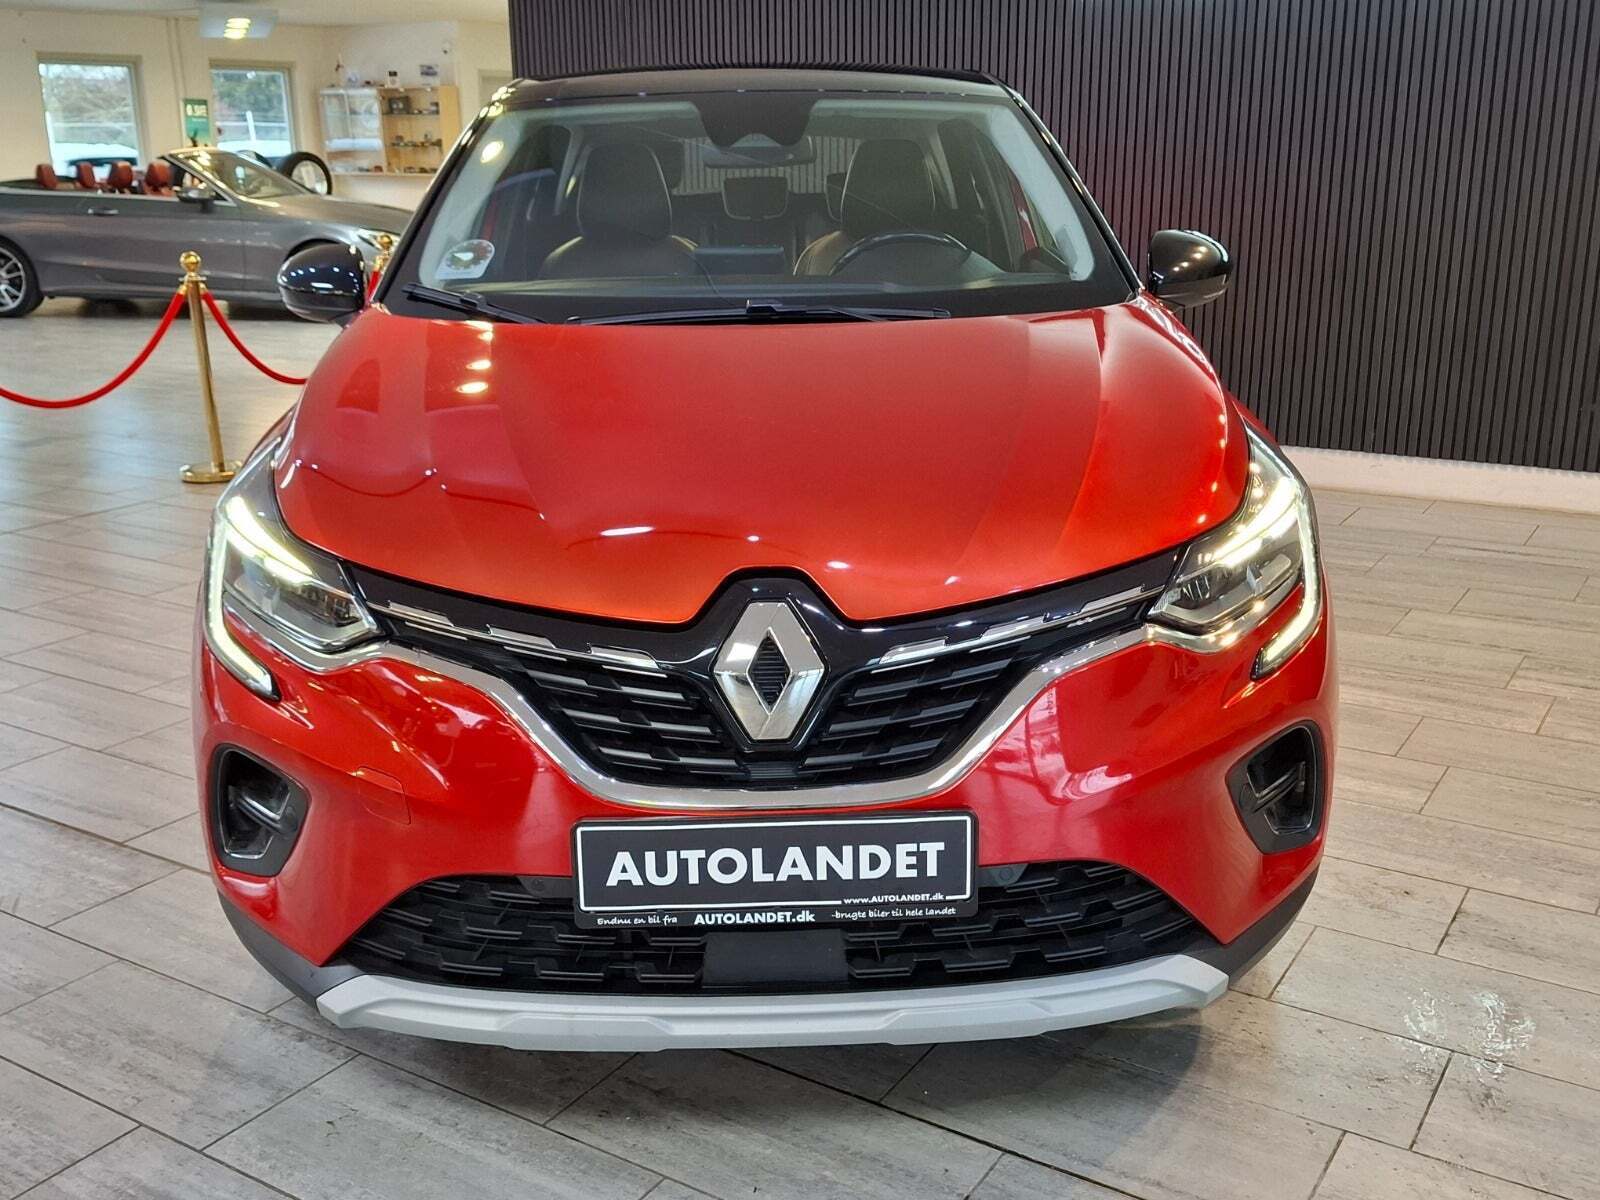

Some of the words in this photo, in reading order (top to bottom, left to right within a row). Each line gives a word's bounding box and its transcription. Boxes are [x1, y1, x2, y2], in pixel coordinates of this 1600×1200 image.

[605, 841, 945, 887] AUTOLANDET
[843, 893, 944, 904] www.AUTOLANDET.dk
[647, 915, 661, 924] bil
[662, 914, 678, 926] fra
[693, 910, 816, 926] AUTOLANDET.dk
[868, 908, 890, 918] biler
[891, 908, 903, 917] til
[905, 907, 923, 917] hele
[925, 906, 957, 916] landet
